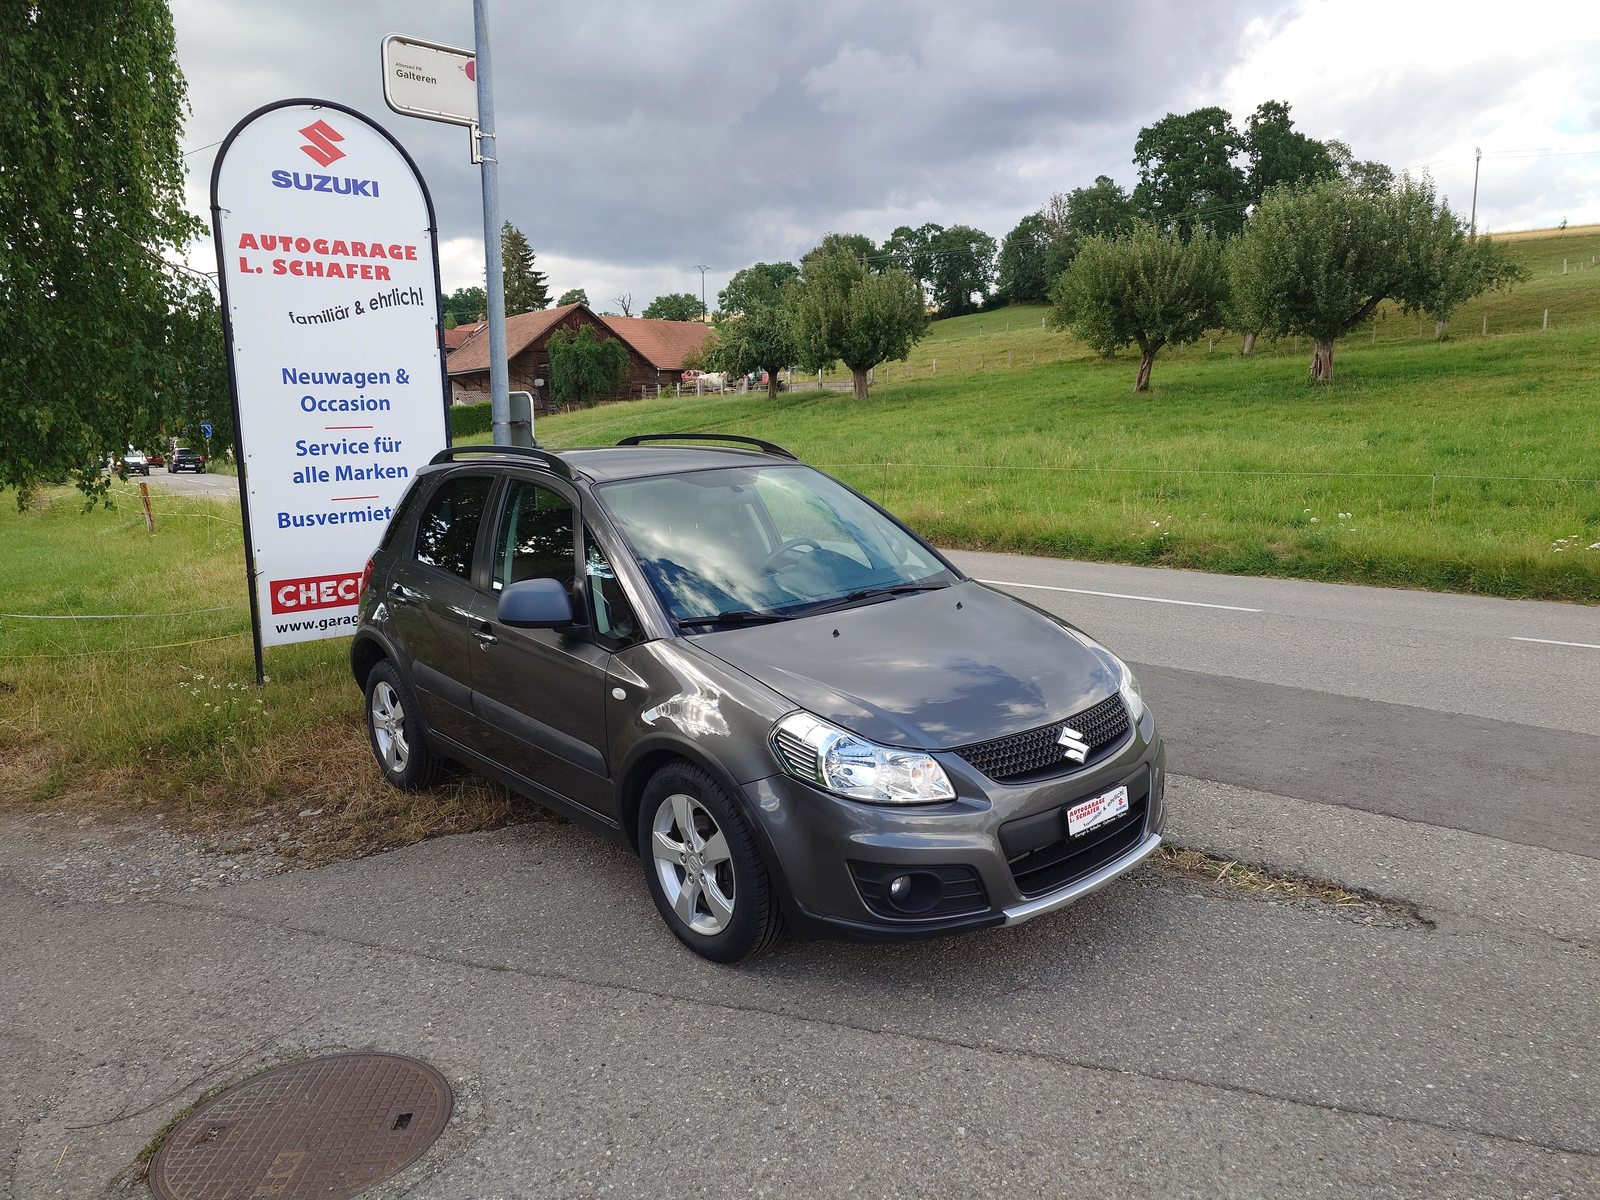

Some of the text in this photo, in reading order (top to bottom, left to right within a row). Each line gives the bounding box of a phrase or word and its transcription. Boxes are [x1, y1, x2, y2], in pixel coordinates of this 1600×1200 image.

[396, 69, 437, 84] Galteren
[271, 170, 379, 197] SUZUKI
[238, 233, 417, 261] AUTOGARAGE
[239, 257, 391, 281] L. SCHAFER
[288, 286, 424, 325] familiär & ehrlich!
[282, 367, 410, 389] Neuwagen &
[300, 395, 391, 412] Occasion
[295, 436, 402, 457] Service für
[292, 463, 409, 484] alle Marken
[277, 505, 395, 529] Busvermiet
[1069, 797, 1105, 817] AUTOGARAGE
